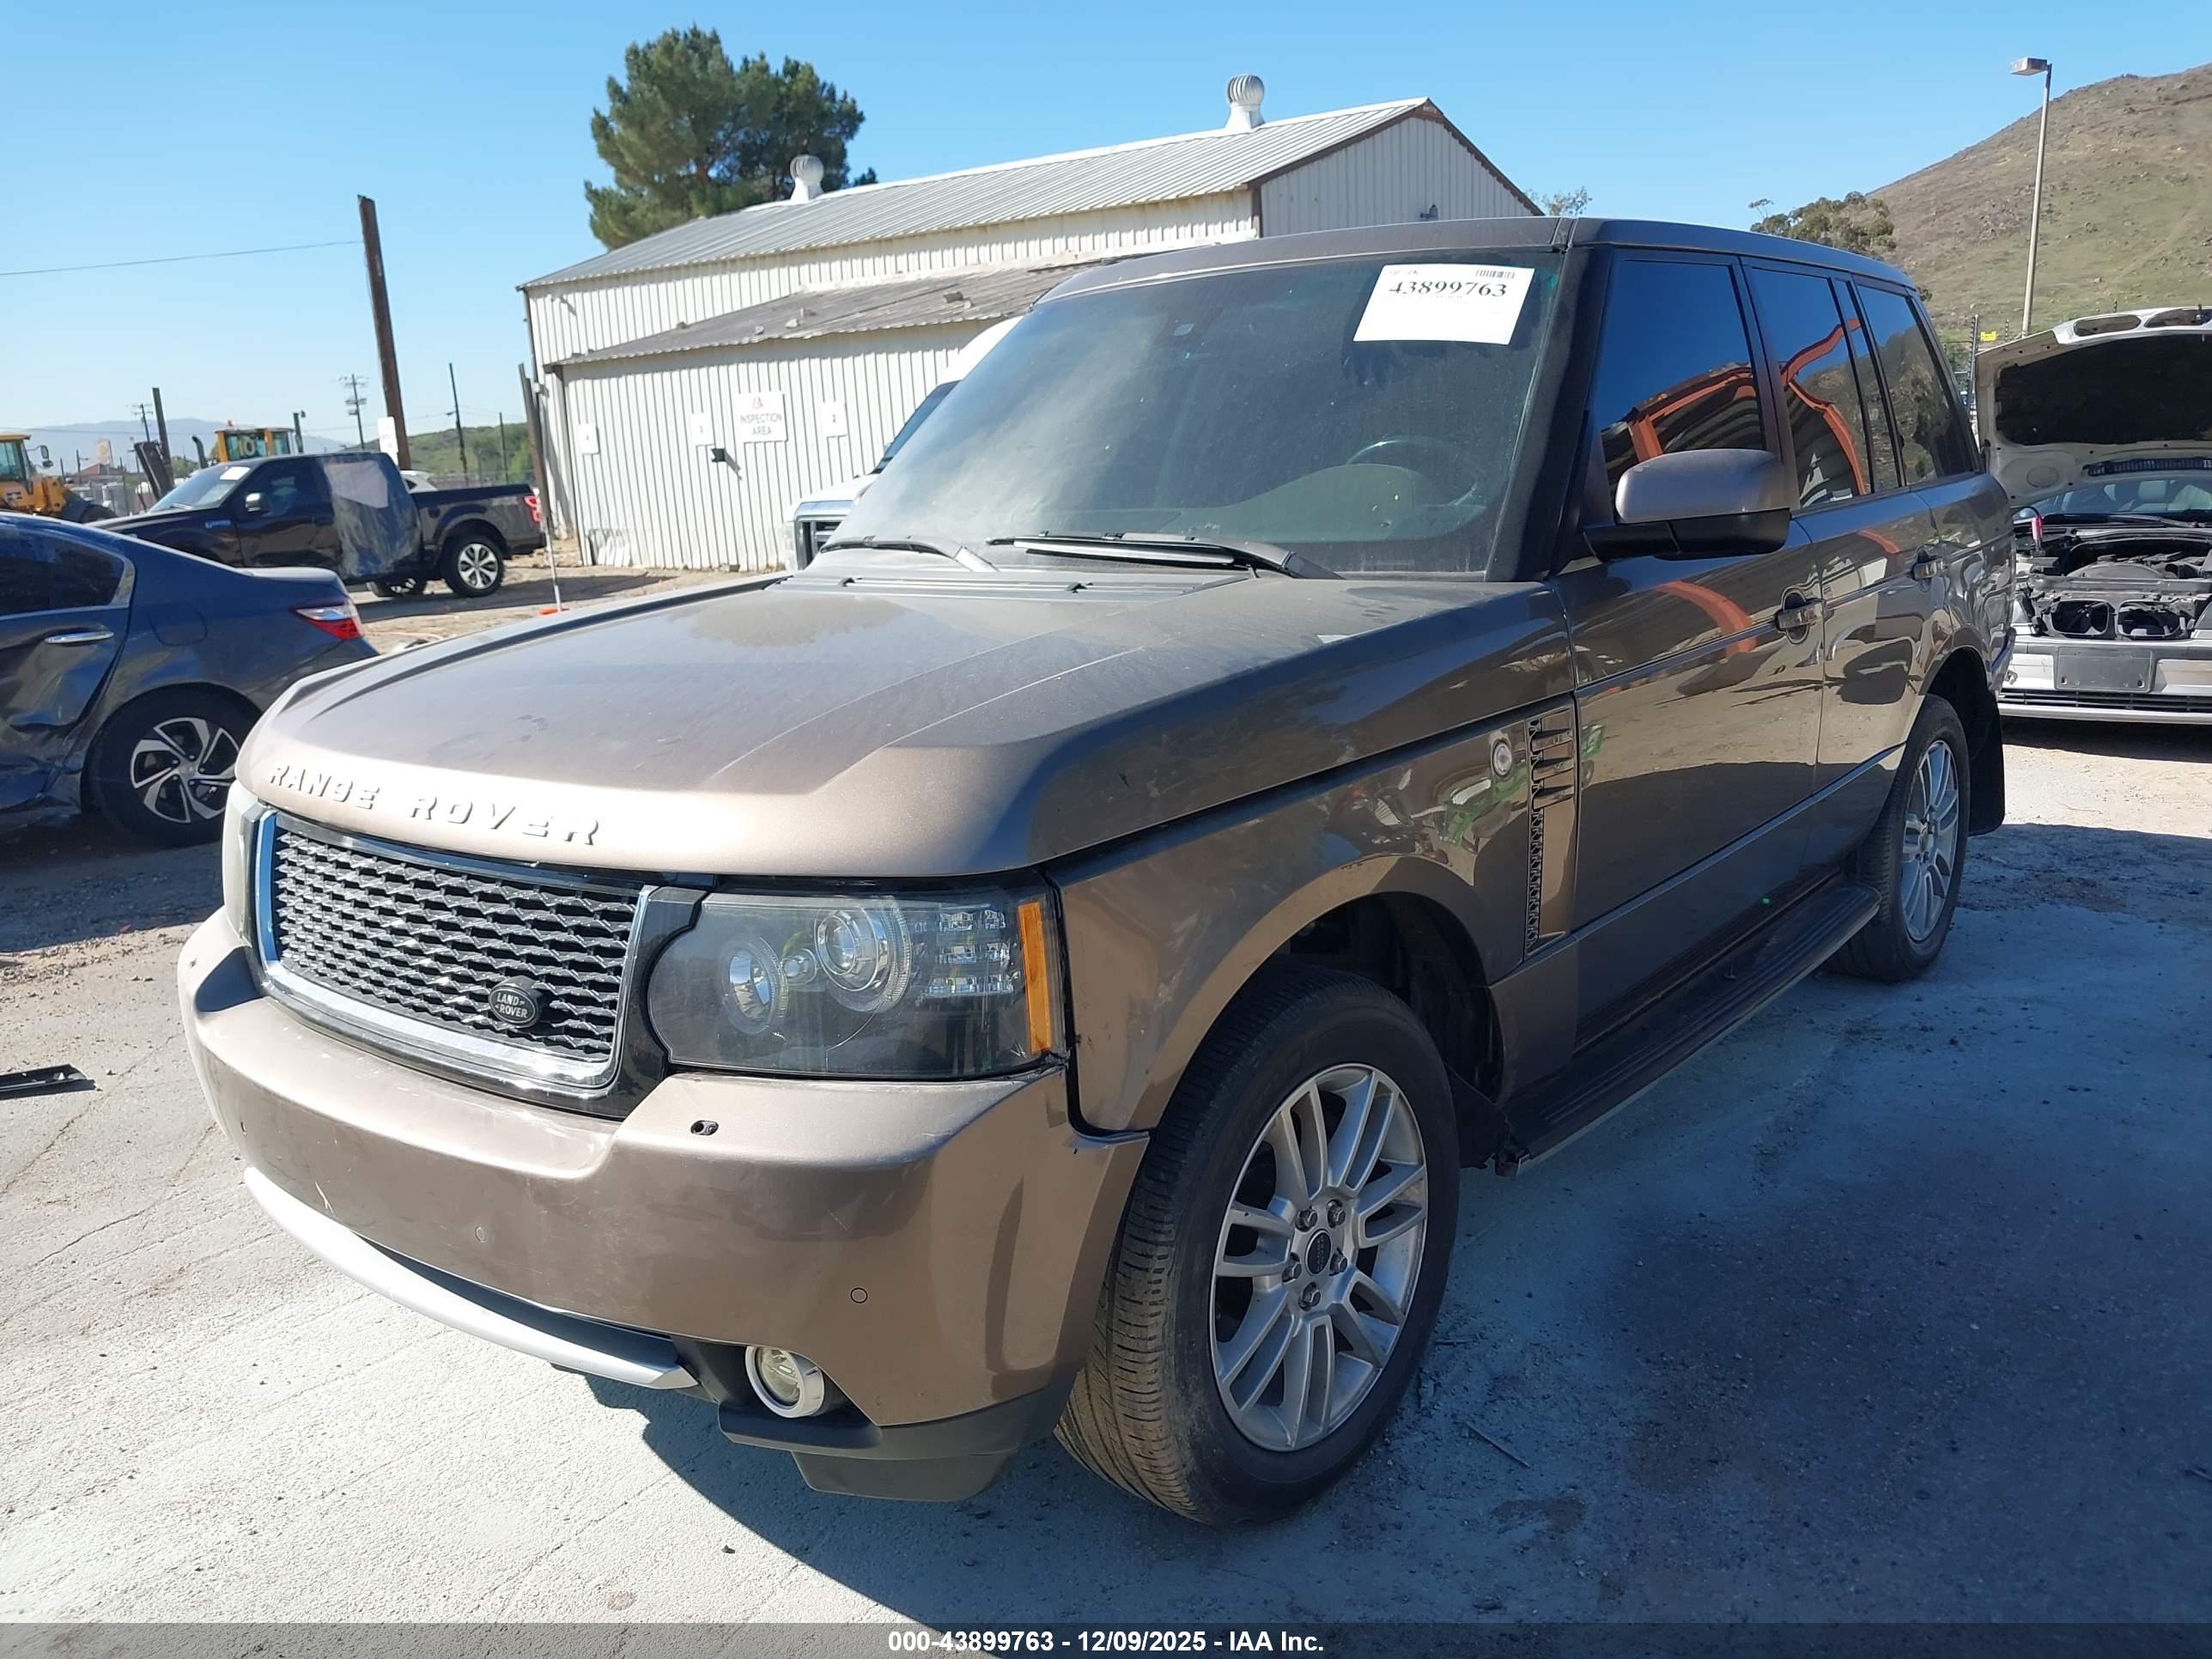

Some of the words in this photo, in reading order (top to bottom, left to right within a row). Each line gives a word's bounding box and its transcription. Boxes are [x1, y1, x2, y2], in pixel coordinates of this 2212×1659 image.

[1389, 281, 1507, 297] 43899763
[739, 412, 782, 424] INSPECTION
[752, 426, 772, 435] AREA
[269, 764, 380, 811] RANGE
[409, 796, 599, 847] ROVER
[496, 992, 520, 1006] LAND
[499, 1004, 528, 1018] ROVER
